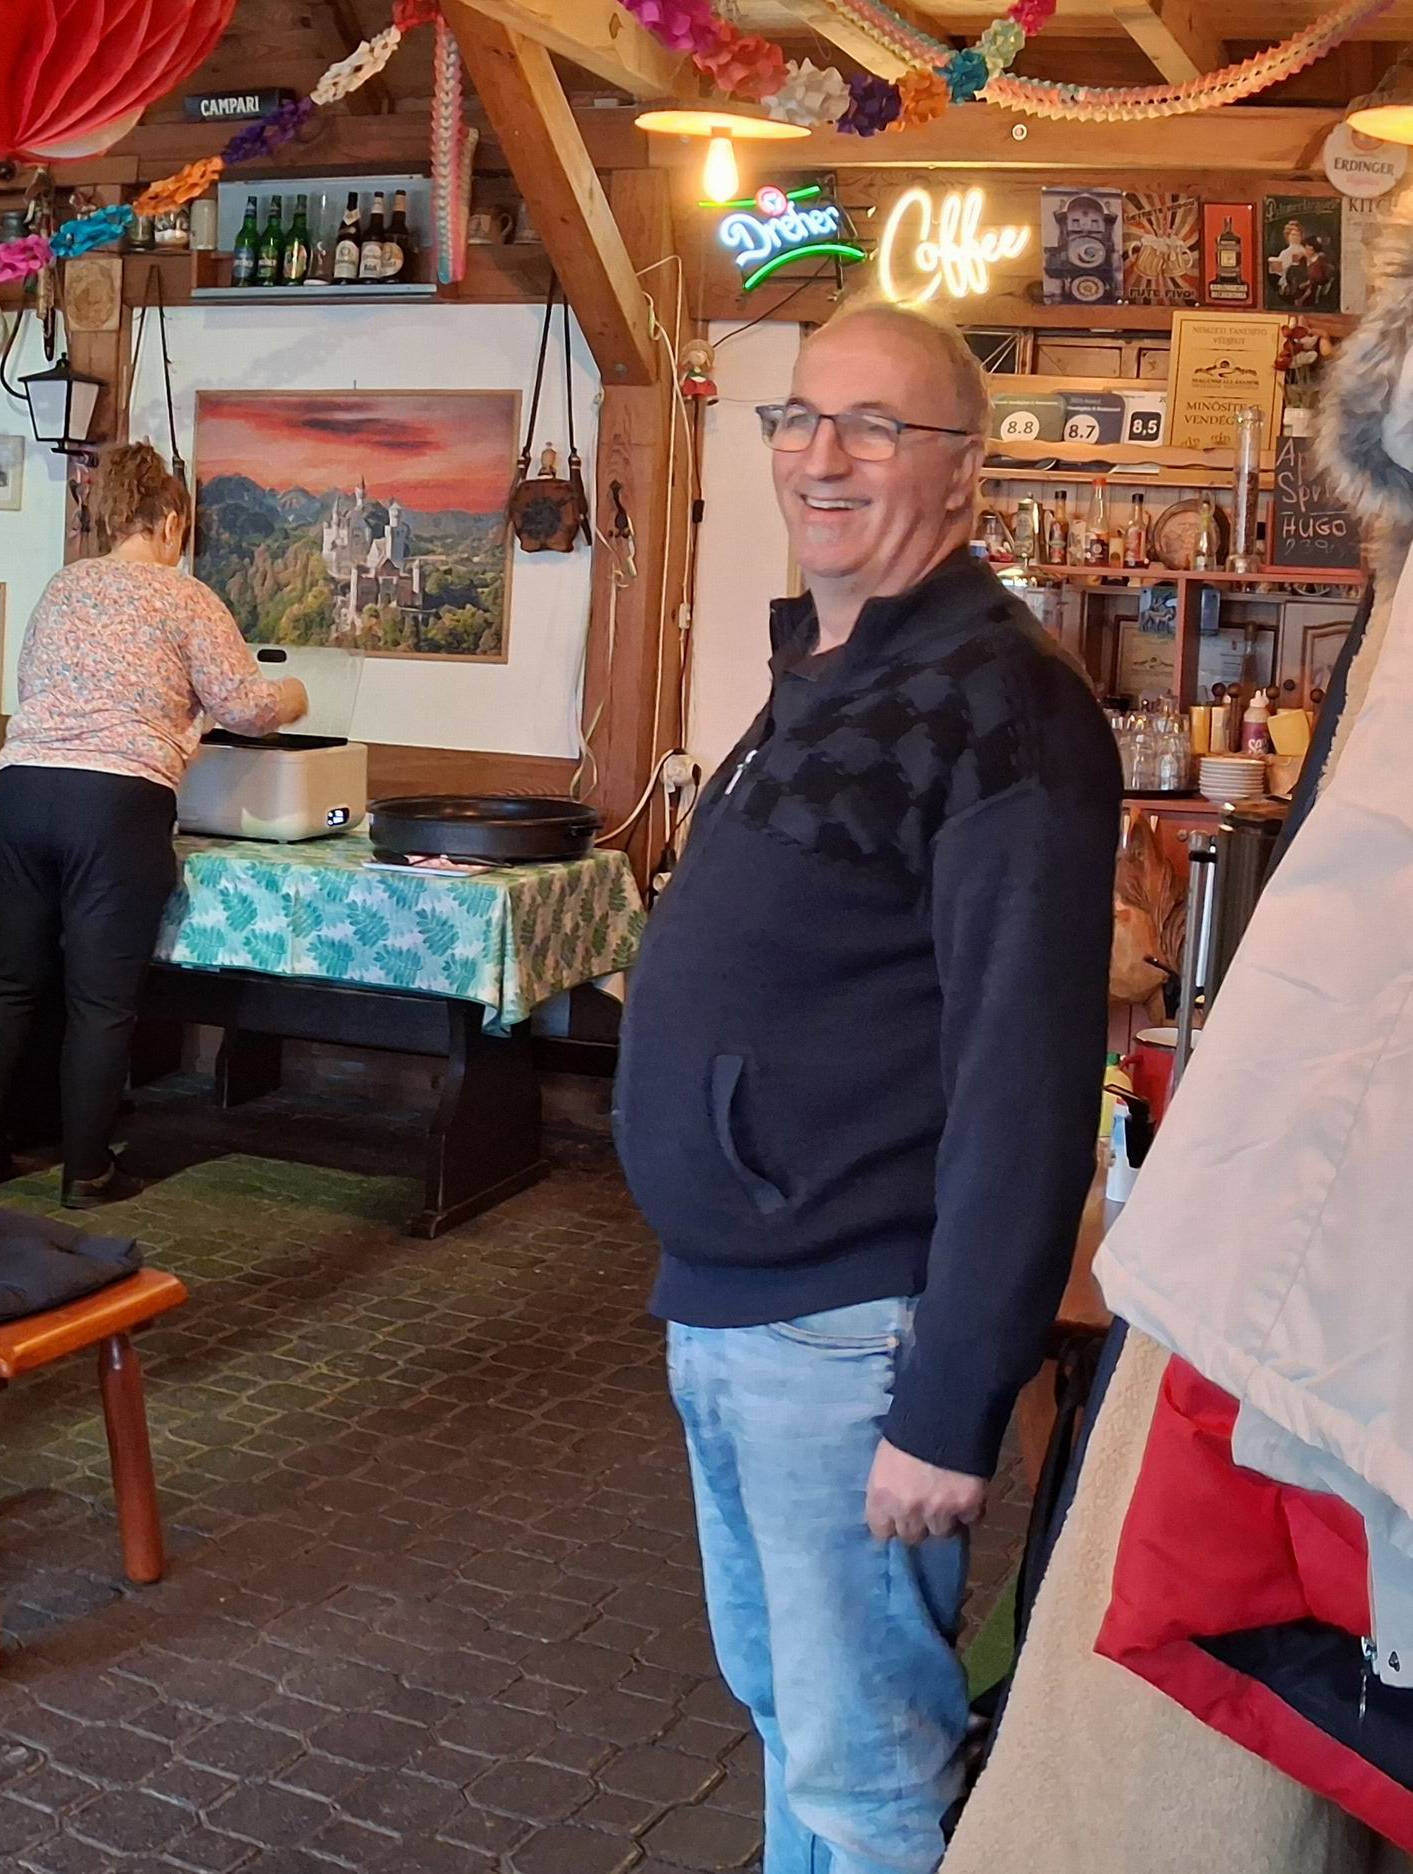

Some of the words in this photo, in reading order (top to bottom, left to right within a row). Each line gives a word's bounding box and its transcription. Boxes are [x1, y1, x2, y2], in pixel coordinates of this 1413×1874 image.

[200, 96, 260, 117] CAMPARI
[1334, 157, 1395, 176] ERDINGER
[719, 202, 840, 266] Dreher
[879, 187, 1031, 305] Coffee
[1007, 421, 1034, 434] 8.8
[1068, 424, 1096, 438] 8.7
[1132, 419, 1158, 436] 8,5
[1282, 515, 1347, 539] HUGO
